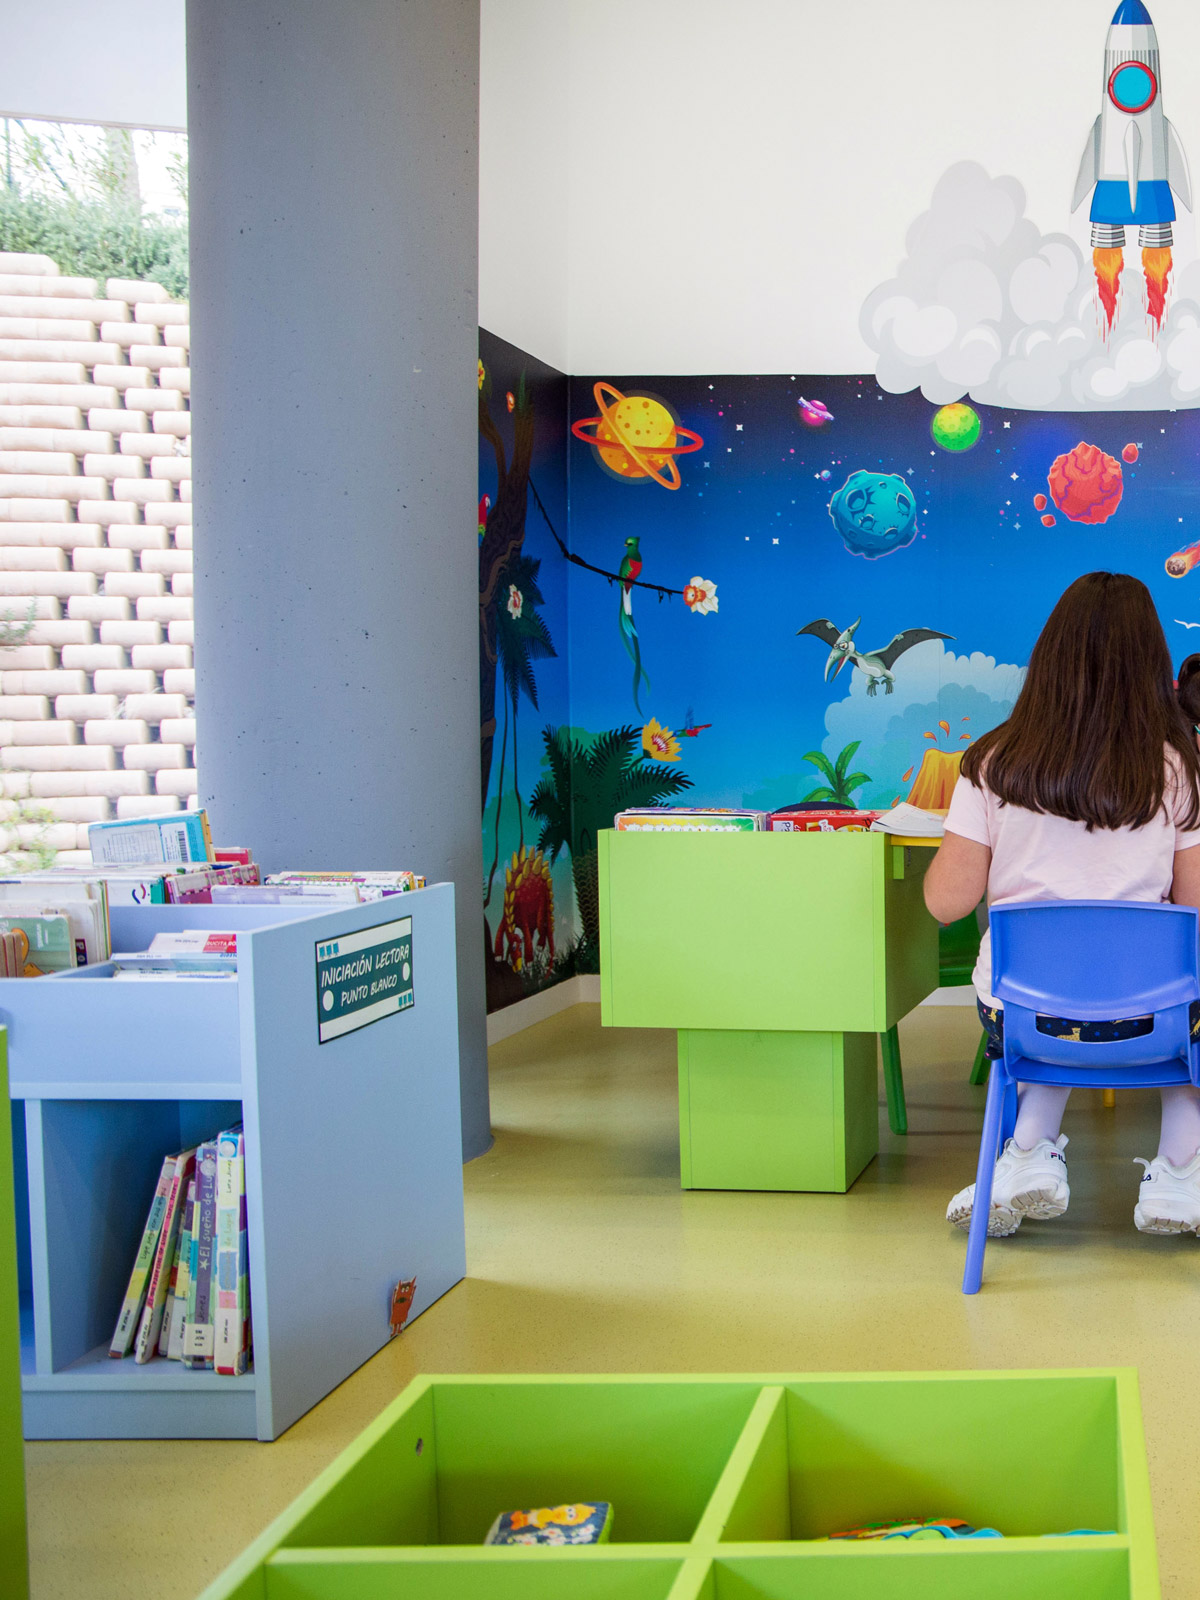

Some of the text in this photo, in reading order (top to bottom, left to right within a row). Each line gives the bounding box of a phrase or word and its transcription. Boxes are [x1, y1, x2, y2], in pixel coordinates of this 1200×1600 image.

[321, 944, 410, 988] INICIACIÓN LECTORA
[341, 974, 398, 1007] PUNTO BLANCO
[202, 1193, 213, 1205] de
[202, 1211, 212, 1242] sueño
[199, 1246, 211, 1257] El
[197, 1295, 207, 1322] Jones
